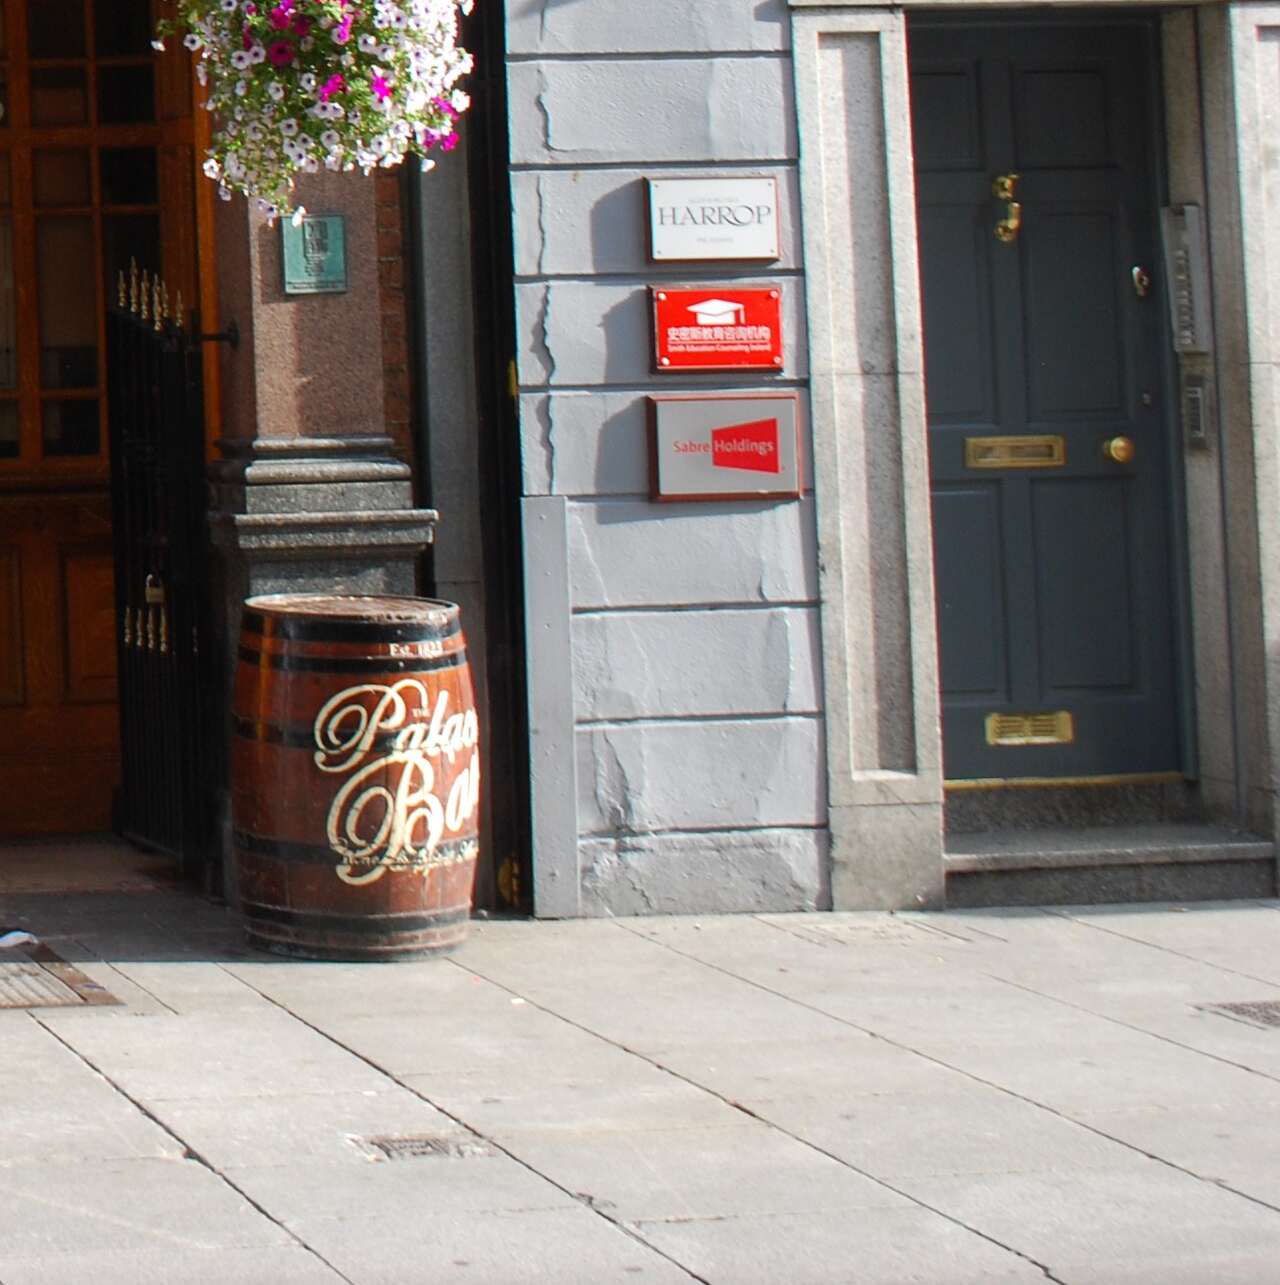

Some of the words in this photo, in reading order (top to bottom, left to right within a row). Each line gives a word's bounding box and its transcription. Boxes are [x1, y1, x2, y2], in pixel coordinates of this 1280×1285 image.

[657, 204, 771, 227] HARROP
[673, 440, 710, 453] Sabre
[714, 438, 774, 456] Holdings
[314, 678, 478, 773] Pala
[327, 749, 480, 885] Ba
